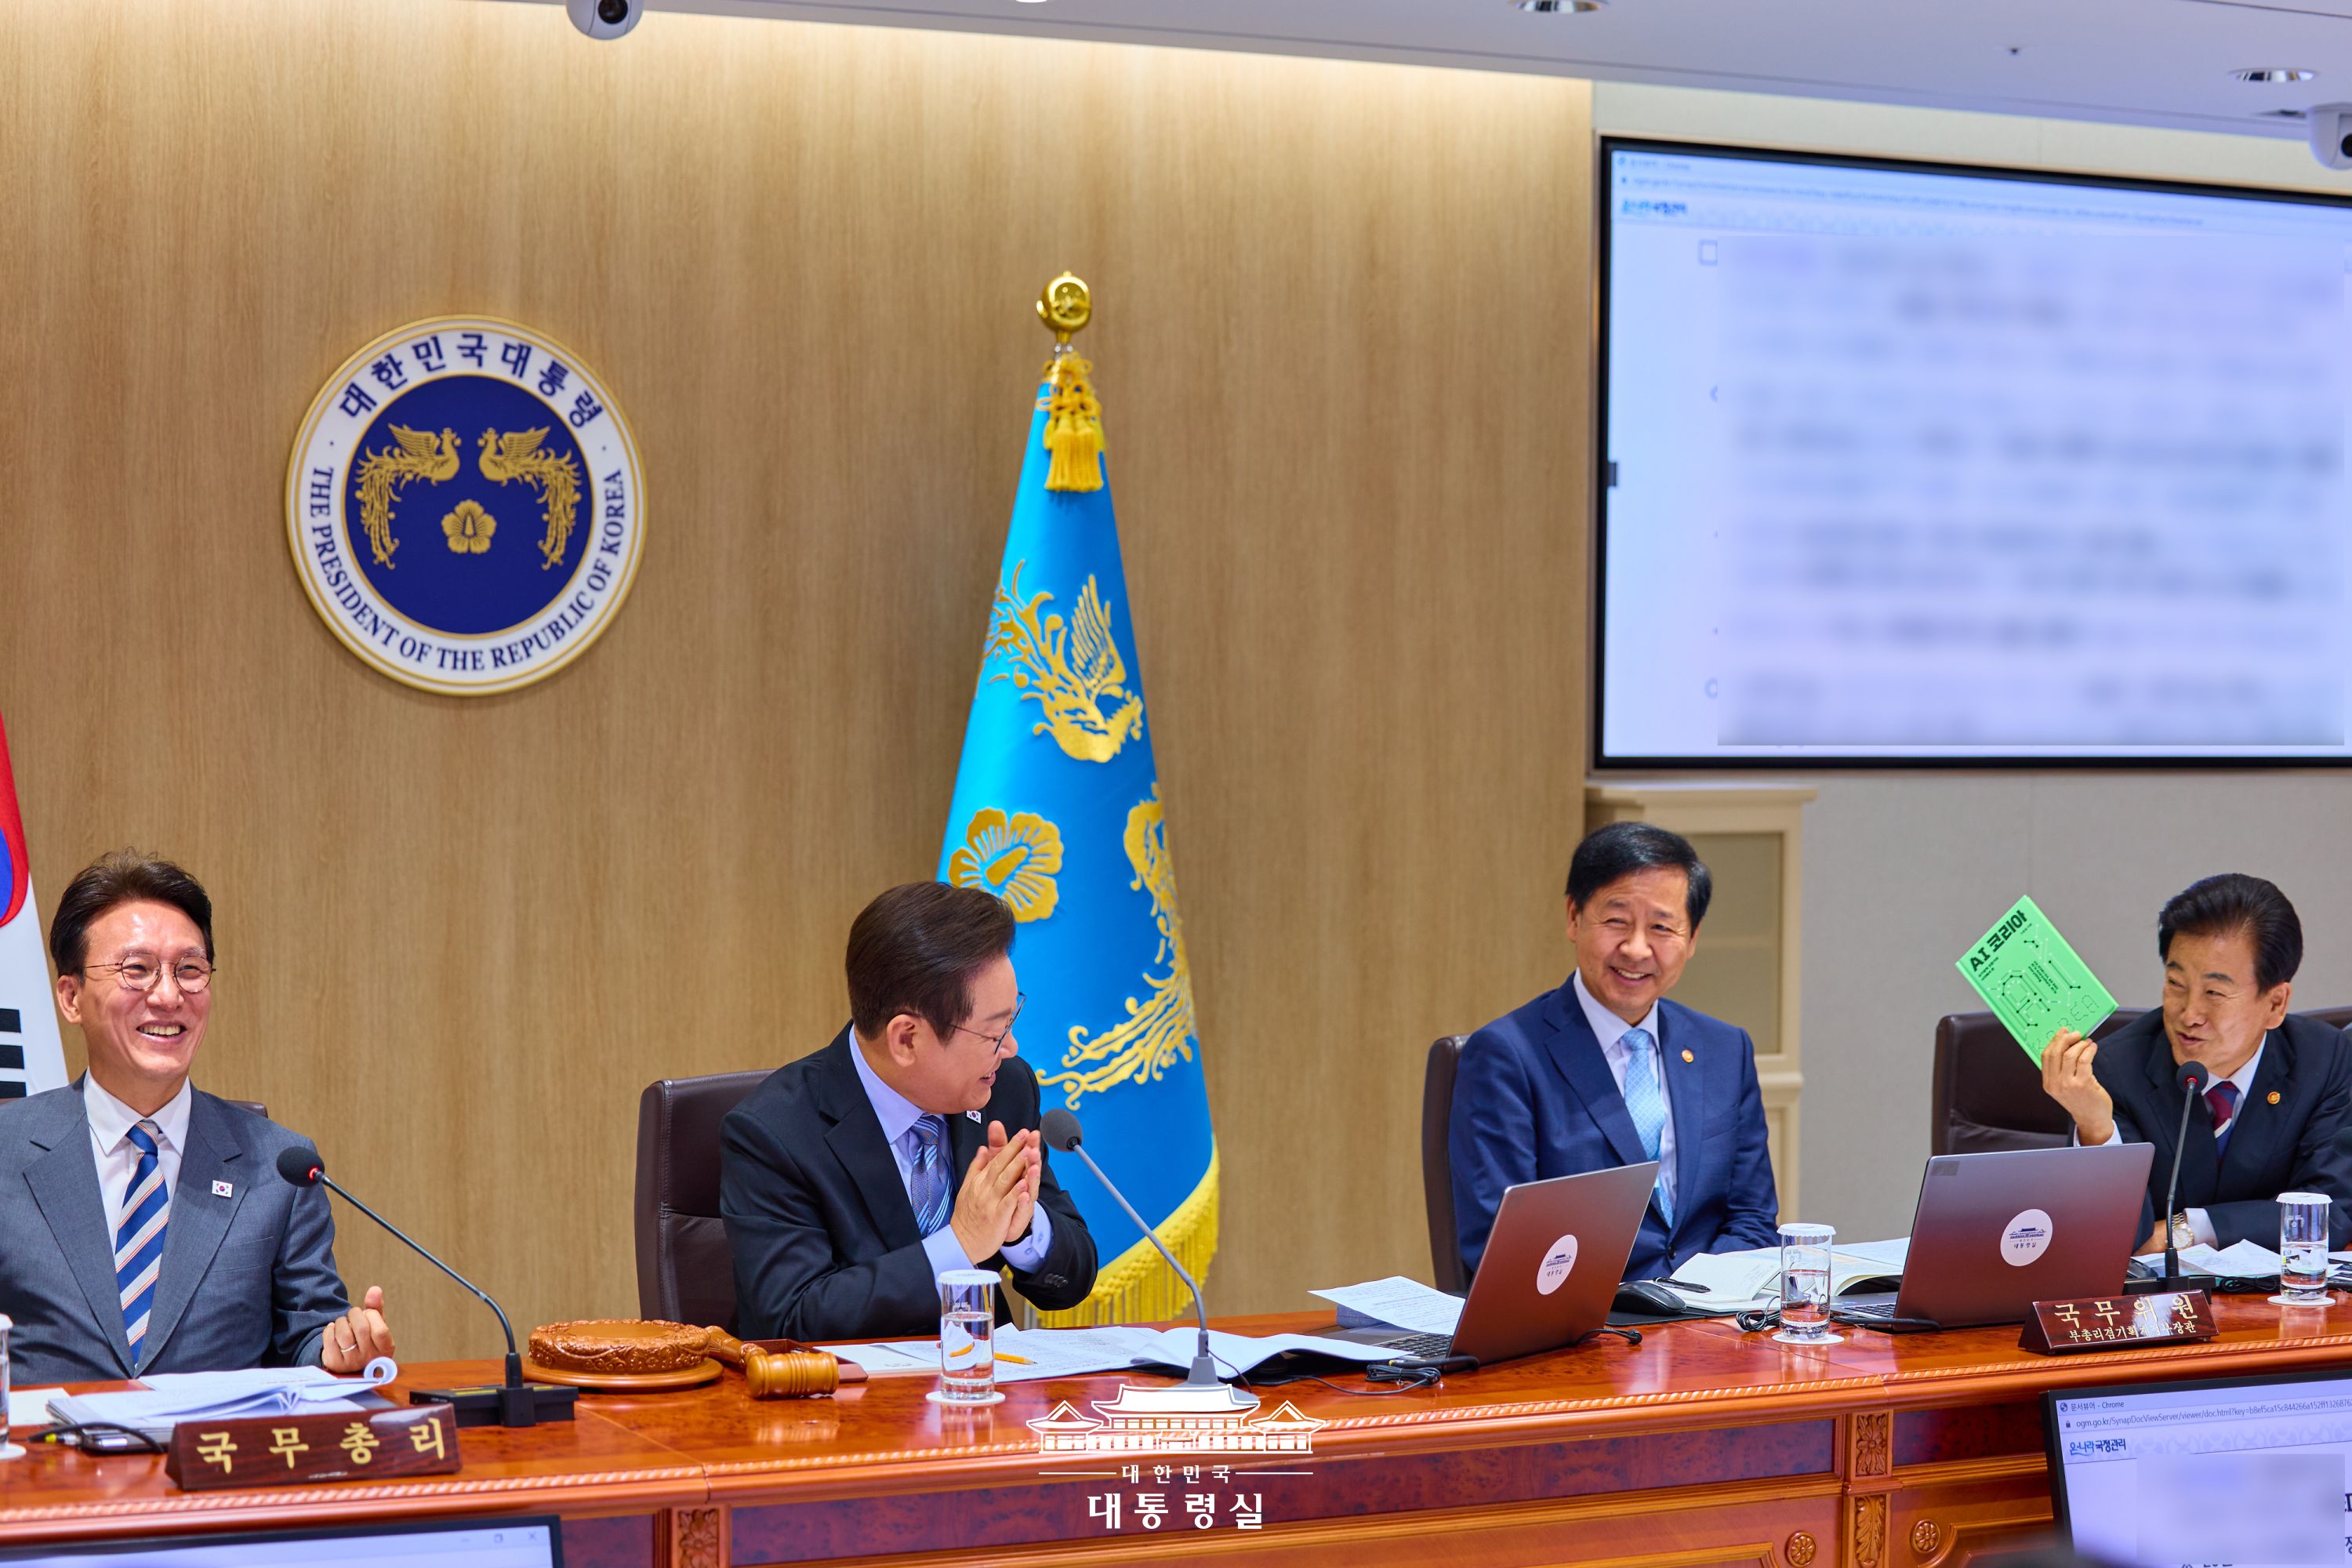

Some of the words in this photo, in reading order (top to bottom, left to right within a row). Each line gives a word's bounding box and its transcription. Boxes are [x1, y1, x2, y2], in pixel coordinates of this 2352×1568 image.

[339, 333, 604, 428] 대한민국대통령
[310, 466, 334, 517] THE
[601, 468, 626, 557] KOREA
[312, 523, 400, 646] PRESIDENT
[586, 558, 612, 593] OF
[398, 636, 432, 663] OF
[491, 590, 595, 670] REPUBLIC
[436, 646, 485, 670] THE
[1969, 946, 1991, 971] AI
[1987, 909, 2027, 953] 코리아
[2054, 1294, 2198, 1329] 국무위원
[2071, 1401, 2096, 1412] 문서뷰어
[2102, 1400, 2125, 1410] Chrome
[197, 1417, 445, 1474] 국무총리
